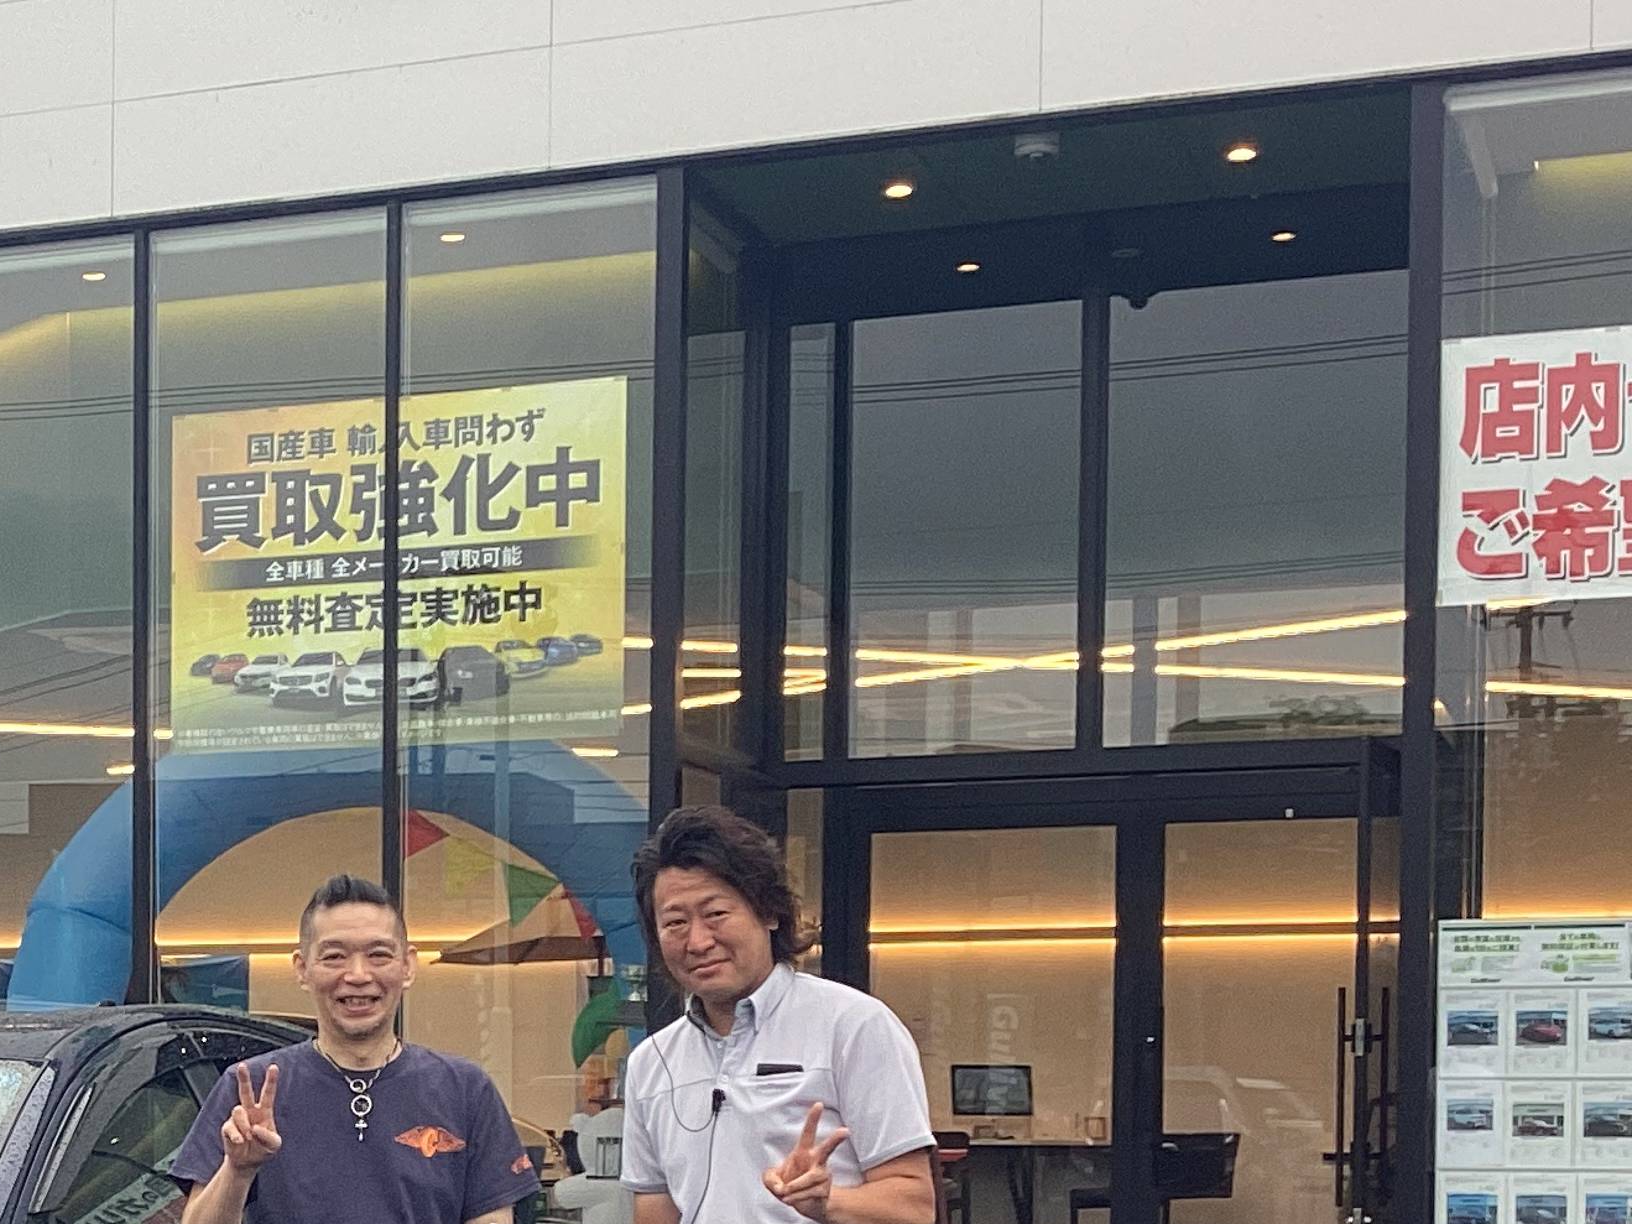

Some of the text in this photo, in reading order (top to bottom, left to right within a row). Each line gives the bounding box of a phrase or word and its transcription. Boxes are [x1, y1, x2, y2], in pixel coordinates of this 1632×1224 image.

[247, 408, 546, 465] 国産車 輸入車問わず
[1459, 353, 1632, 463] 店内
[195, 446, 600, 554] 買取強化中
[1456, 475, 1632, 581] ご希
[265, 545, 523, 582] 全車種 全メーカー買取可能
[246, 580, 542, 638] 無料査定実施中
